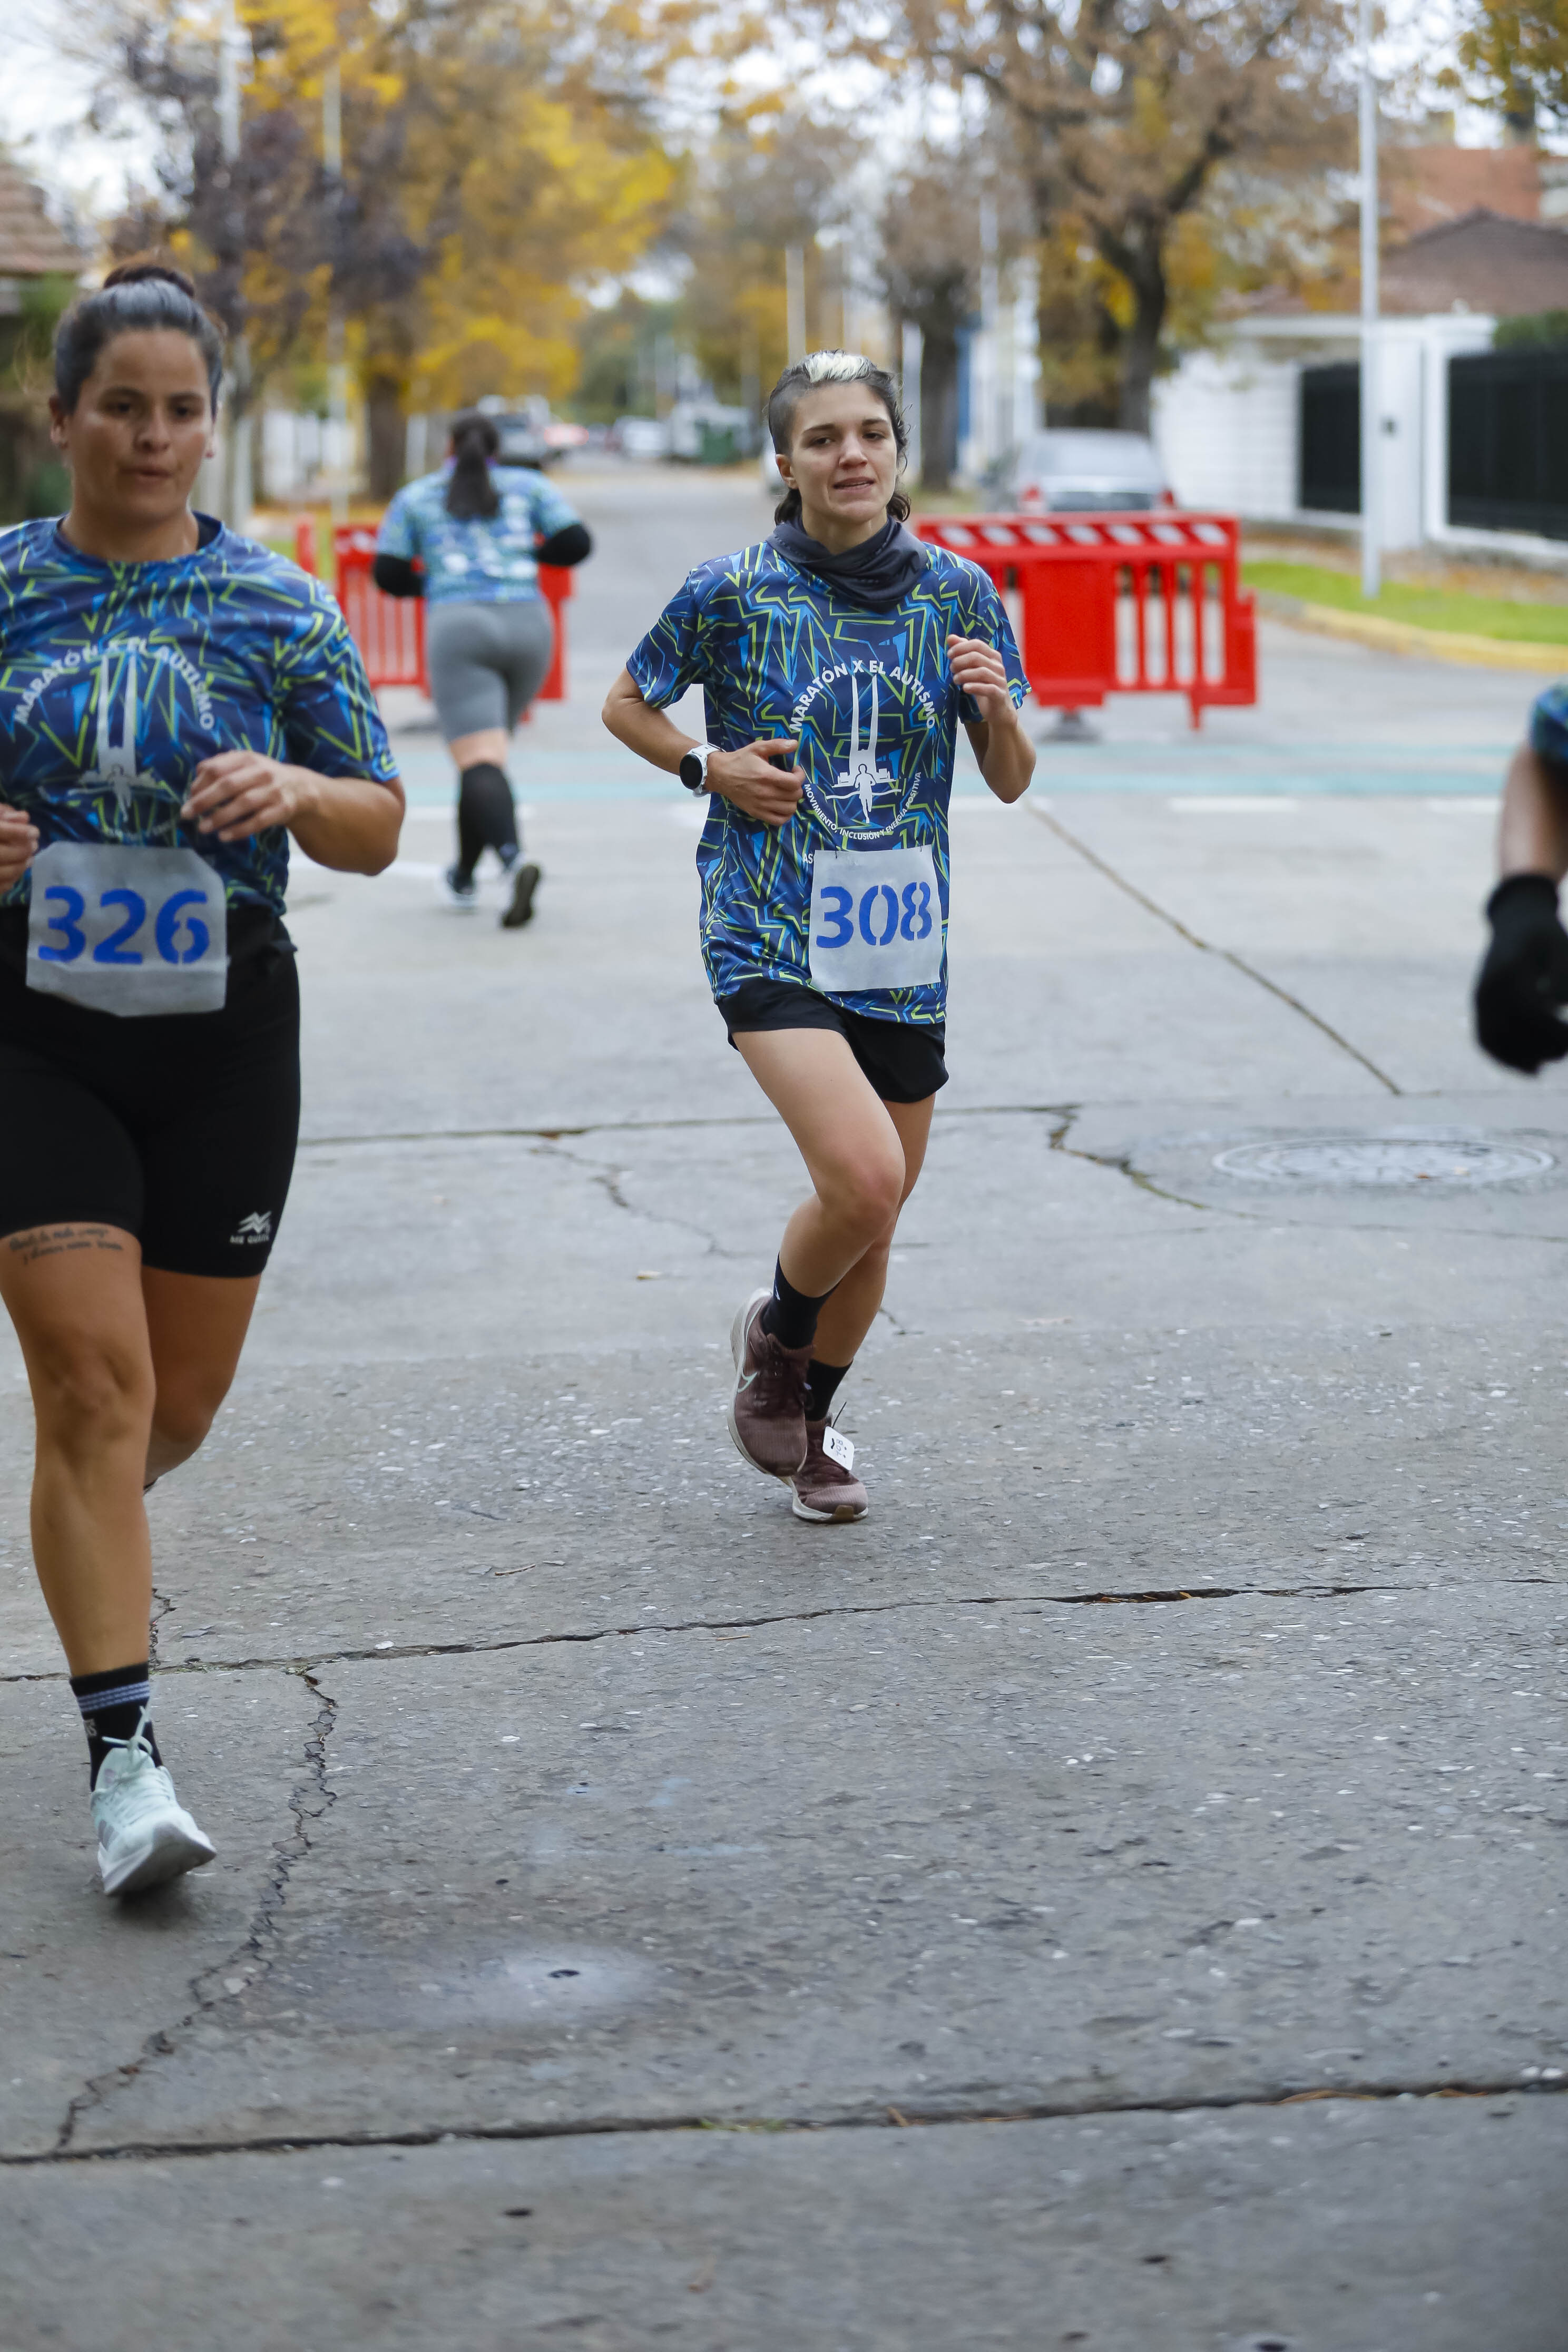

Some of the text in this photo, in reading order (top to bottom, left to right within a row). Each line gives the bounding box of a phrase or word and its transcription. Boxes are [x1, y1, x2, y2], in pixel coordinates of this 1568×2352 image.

[789, 660, 935, 732] MARATÓN X EL AUTISMO
[804, 783, 838, 834] MOVIMIENTO,
[839, 828, 880, 840] INCLUSIÓN
[886, 808, 908, 834] ENERGÍA
[905, 771, 922, 809] POSITIVA
[38, 885, 210, 965] 326
[816, 880, 933, 949] 308
